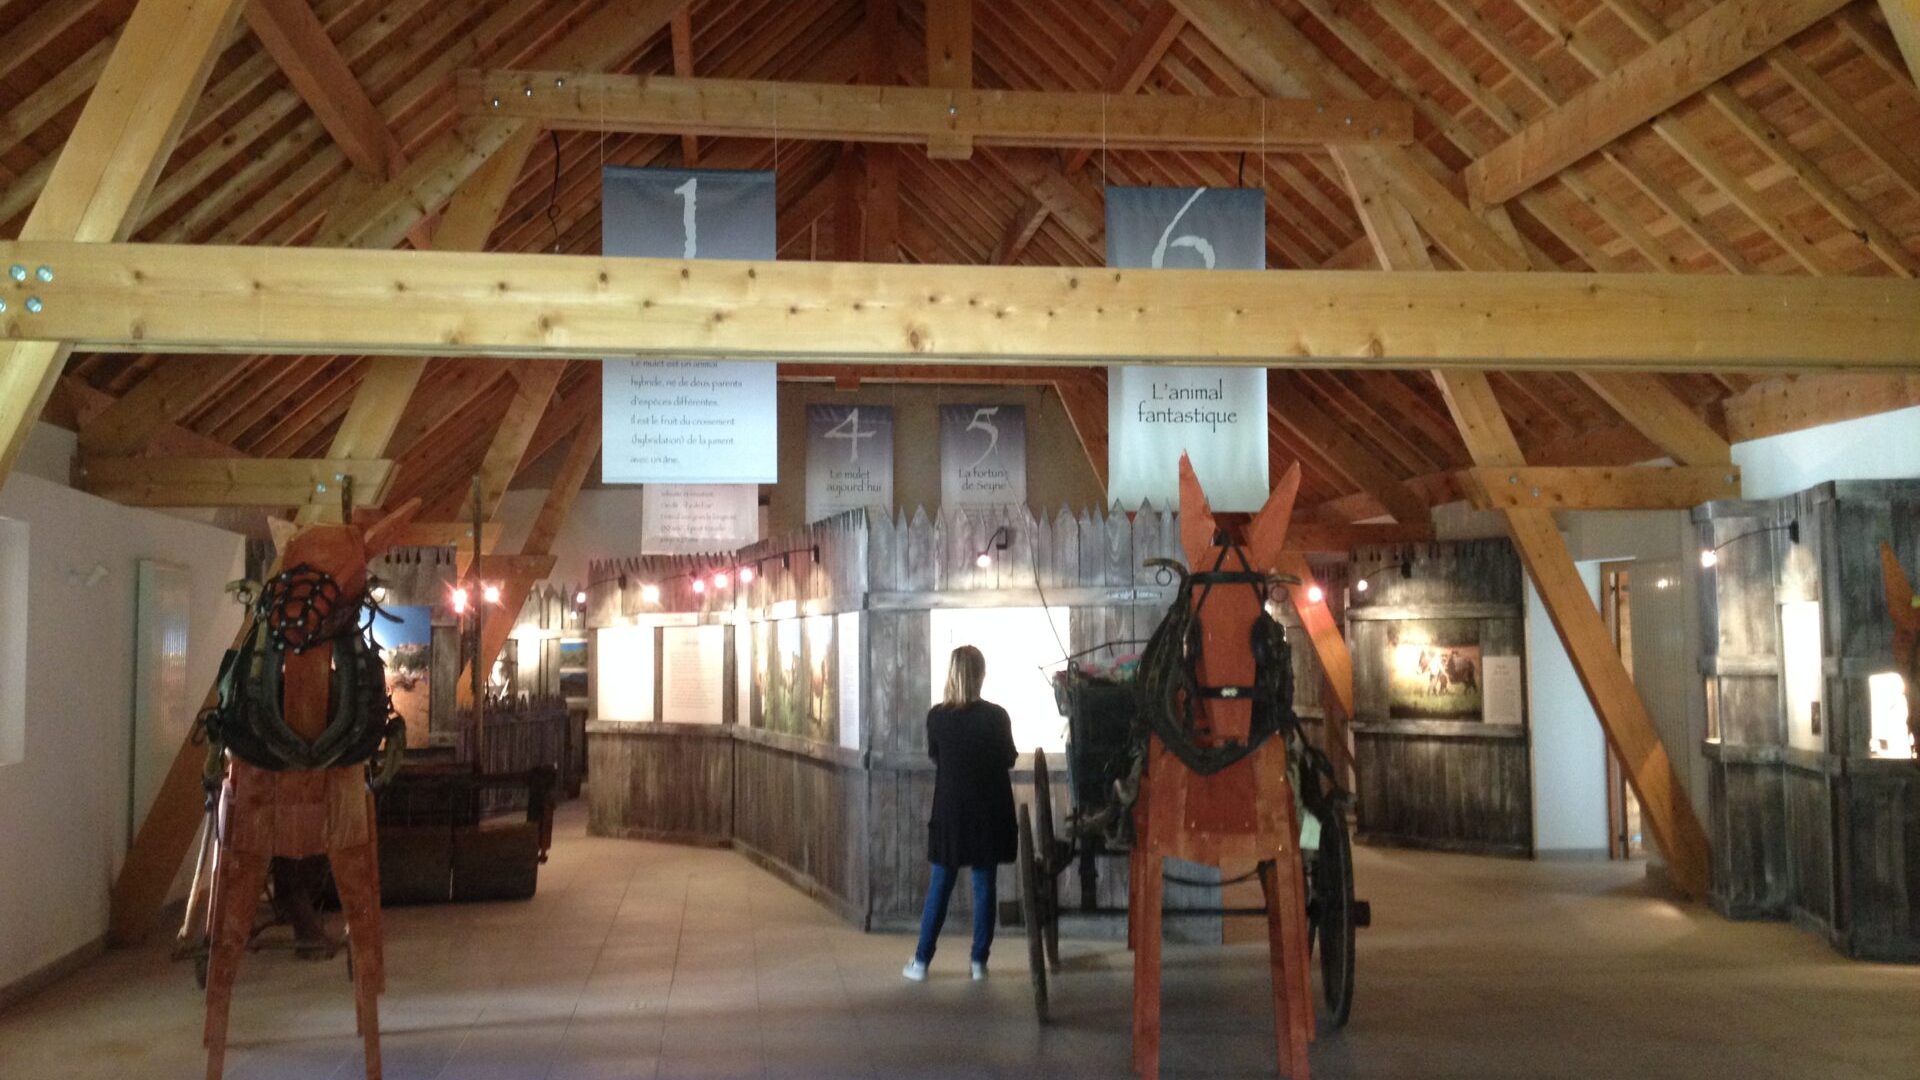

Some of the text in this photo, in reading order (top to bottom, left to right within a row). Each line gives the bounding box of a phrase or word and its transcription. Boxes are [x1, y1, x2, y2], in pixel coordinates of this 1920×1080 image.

[674, 178, 697, 258] 1
[1152, 186, 1216, 269] 6
[678, 375, 689, 387] de
[711, 379, 743, 392] parents
[1152, 378, 1223, 400] L'animal
[637, 417, 649, 425] est
[651, 414, 660, 425] le
[661, 414, 678, 425] fruit
[680, 414, 691, 425] du
[1138, 400, 1238, 433] fantastique
[687, 433, 697, 444] de
[699, 433, 707, 444] la
[707, 436, 734, 448] jument
[824, 407, 877, 464] 4
[966, 406, 999, 468] 5
[830, 465, 870, 479] Le mulet
[959, 468, 971, 478] La
[826, 477, 881, 498] aujourd'hui
[961, 476, 974, 490] de
